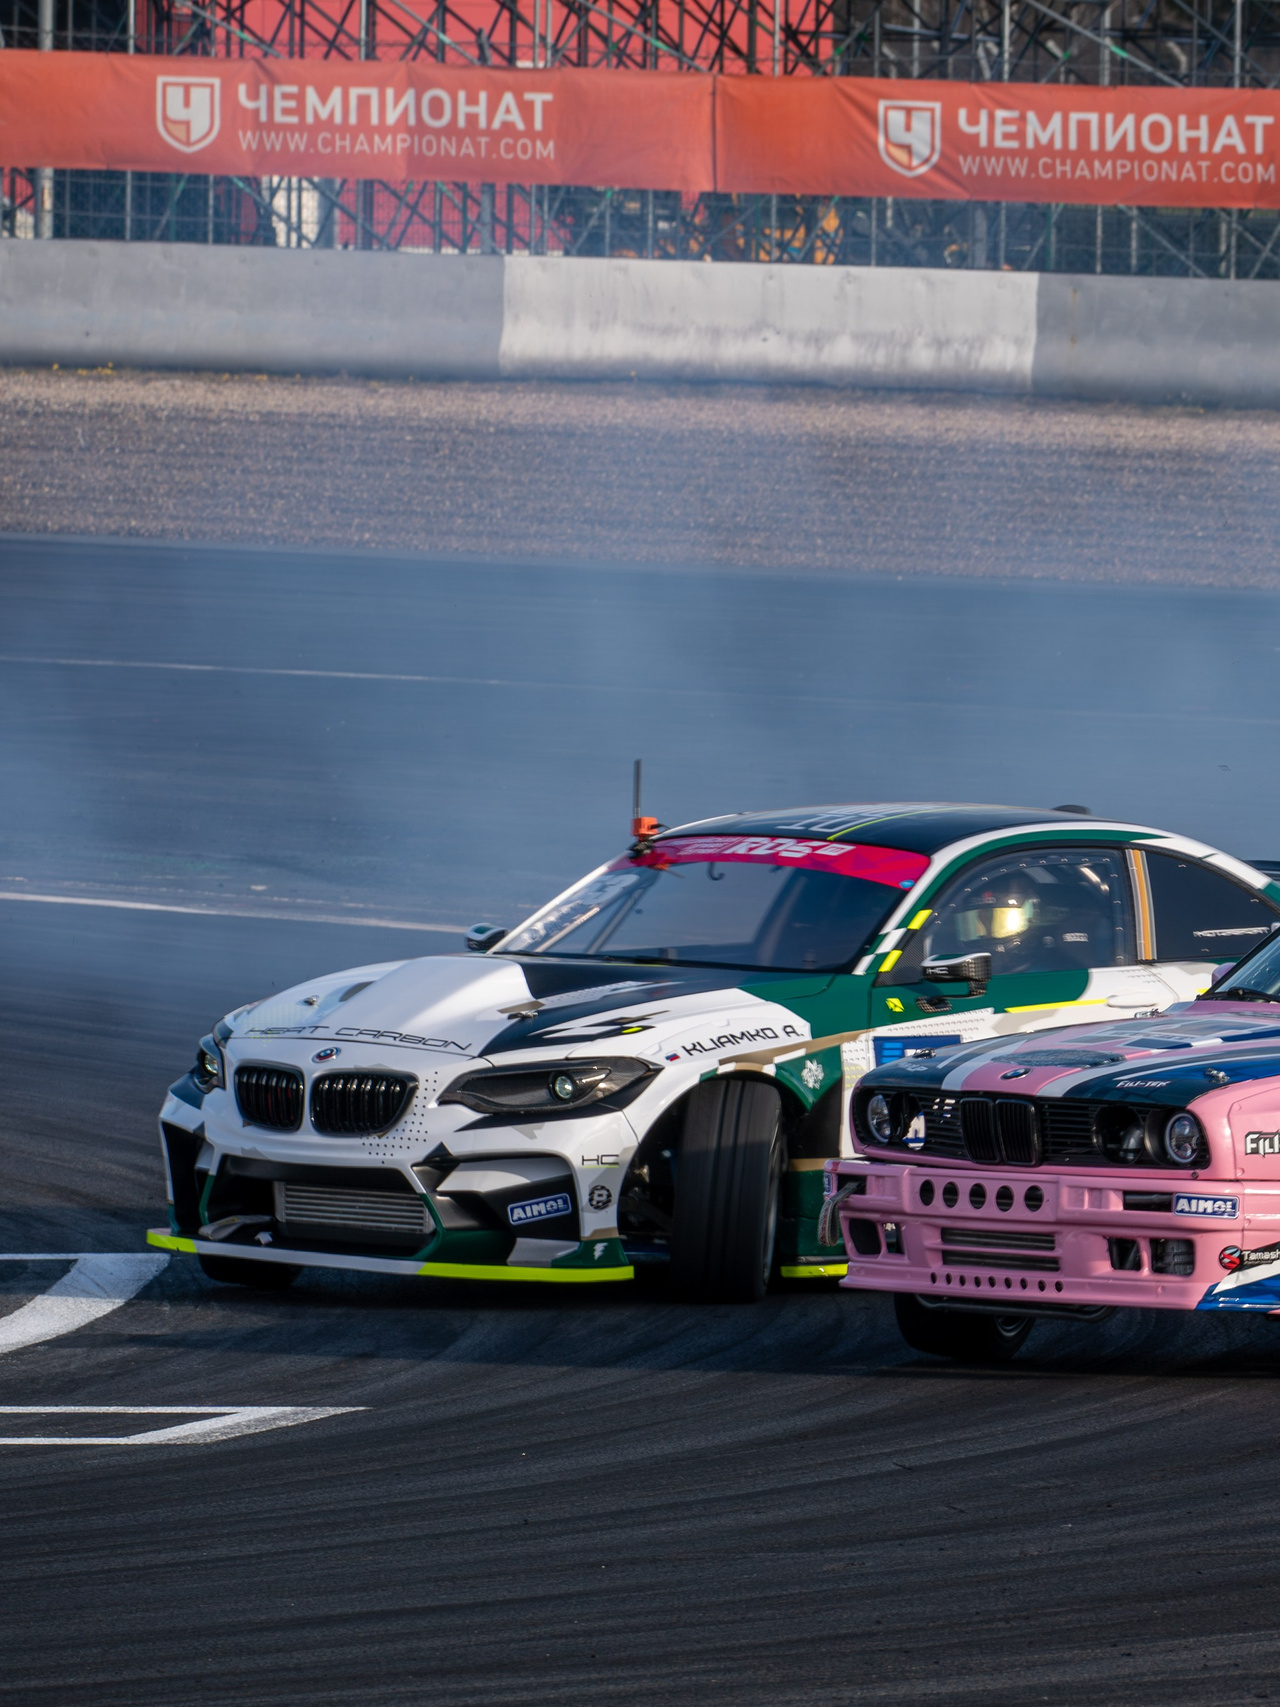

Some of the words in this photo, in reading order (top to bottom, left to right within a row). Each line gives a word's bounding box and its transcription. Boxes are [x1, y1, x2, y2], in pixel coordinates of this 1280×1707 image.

[238, 83, 553, 132] ЧЕМПИОНАТ
[239, 128, 556, 161] WWW.CHAMPIONAT.COM
[958, 108, 1275, 155] ЧЕМПИОНАТ
[958, 155, 1276, 184] WWW.CHAMPIONAT.COM
[245, 1025, 329, 1036] HEAT
[335, 1027, 472, 1051] CARBON
[682, 1027, 779, 1056] KLIAMKO
[782, 1024, 805, 1038] A.
[581, 1154, 619, 1166] HC
[512, 1196, 568, 1221] AIMOL
[1175, 1198, 1236, 1215] AIMOL
